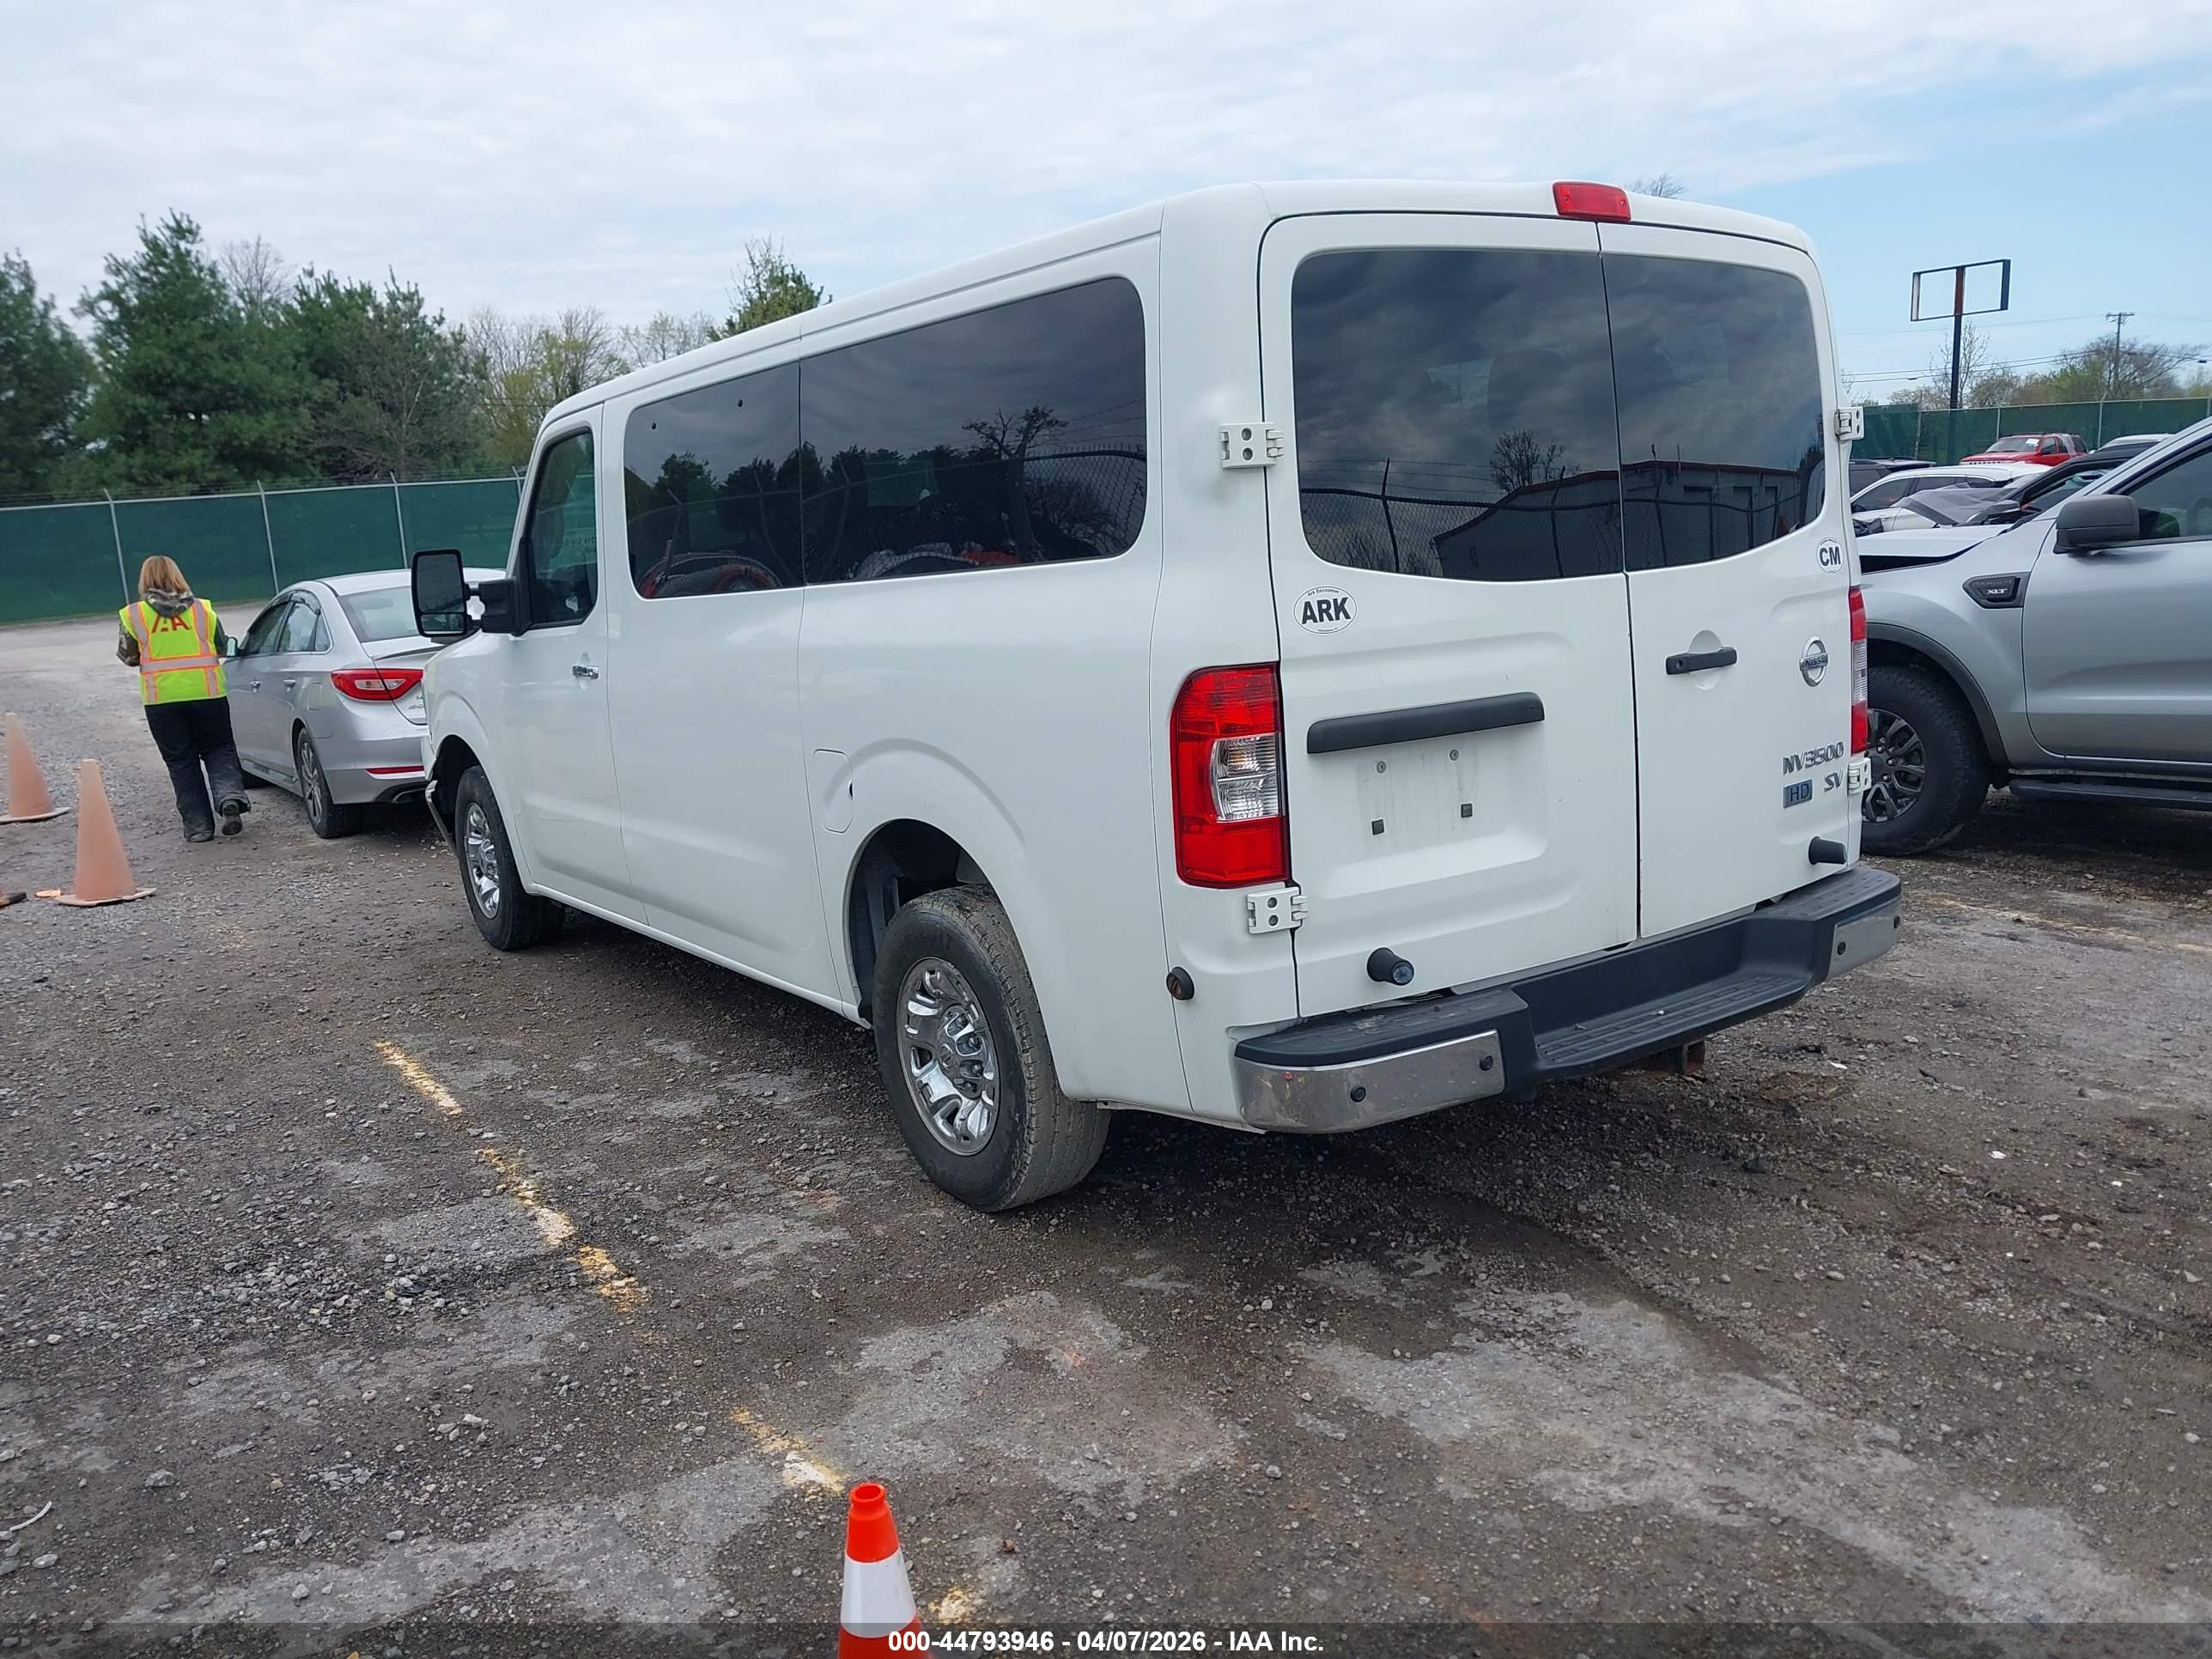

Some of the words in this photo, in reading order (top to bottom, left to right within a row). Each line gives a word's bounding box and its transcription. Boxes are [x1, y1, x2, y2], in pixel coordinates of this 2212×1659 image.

[1820, 546, 1841, 567] CM
[1302, 597, 1351, 624] ARK
[1784, 741, 1844, 775] NV3500
[1790, 783, 1810, 802] HD
[1824, 769, 1844, 793] SV
